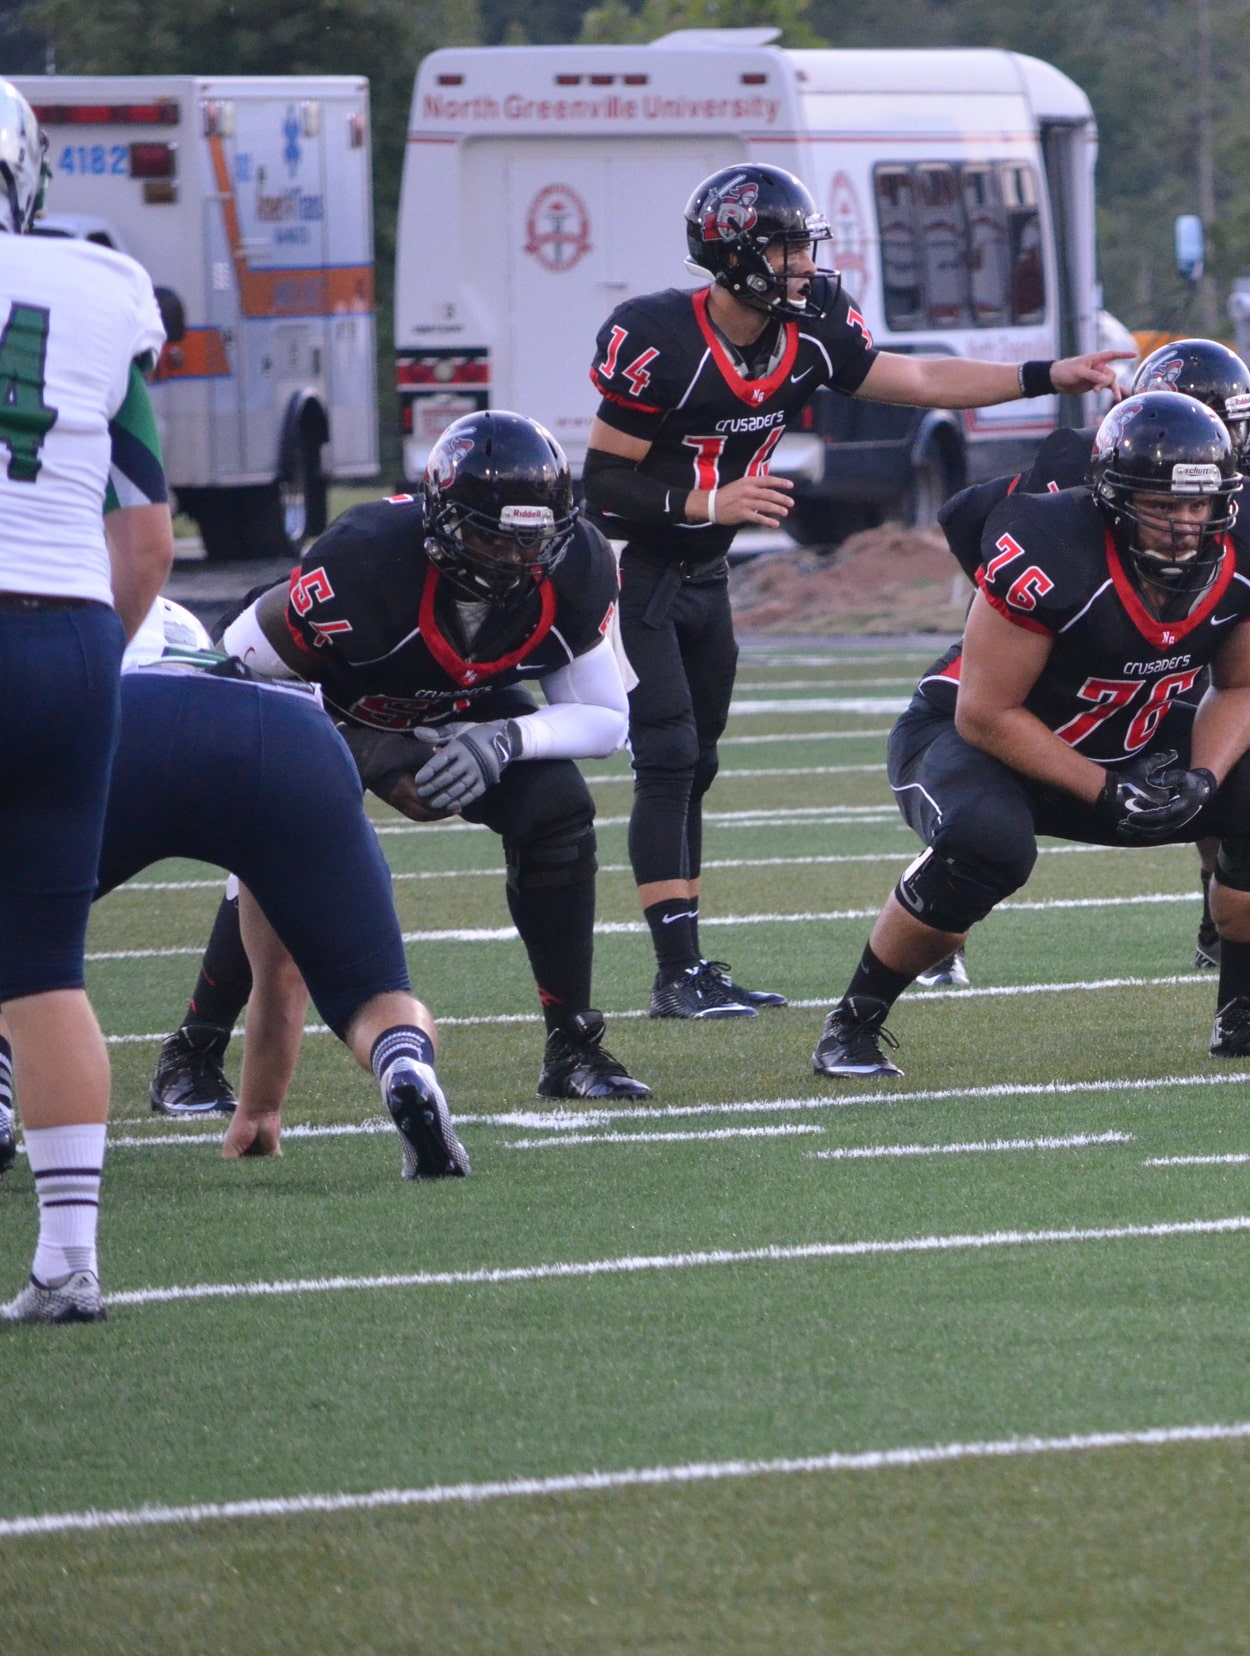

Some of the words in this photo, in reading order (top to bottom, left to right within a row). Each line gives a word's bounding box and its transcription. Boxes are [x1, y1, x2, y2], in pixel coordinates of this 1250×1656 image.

[423, 93, 498, 120] North
[503, 93, 639, 120] Greenville
[643, 95, 780, 124] University
[58, 145, 128, 176] 4182
[598, 325, 661, 397] 14
[513, 509, 541, 518] Riddell
[984, 532, 1055, 612] 76
[1053, 665, 1203, 752] 76
